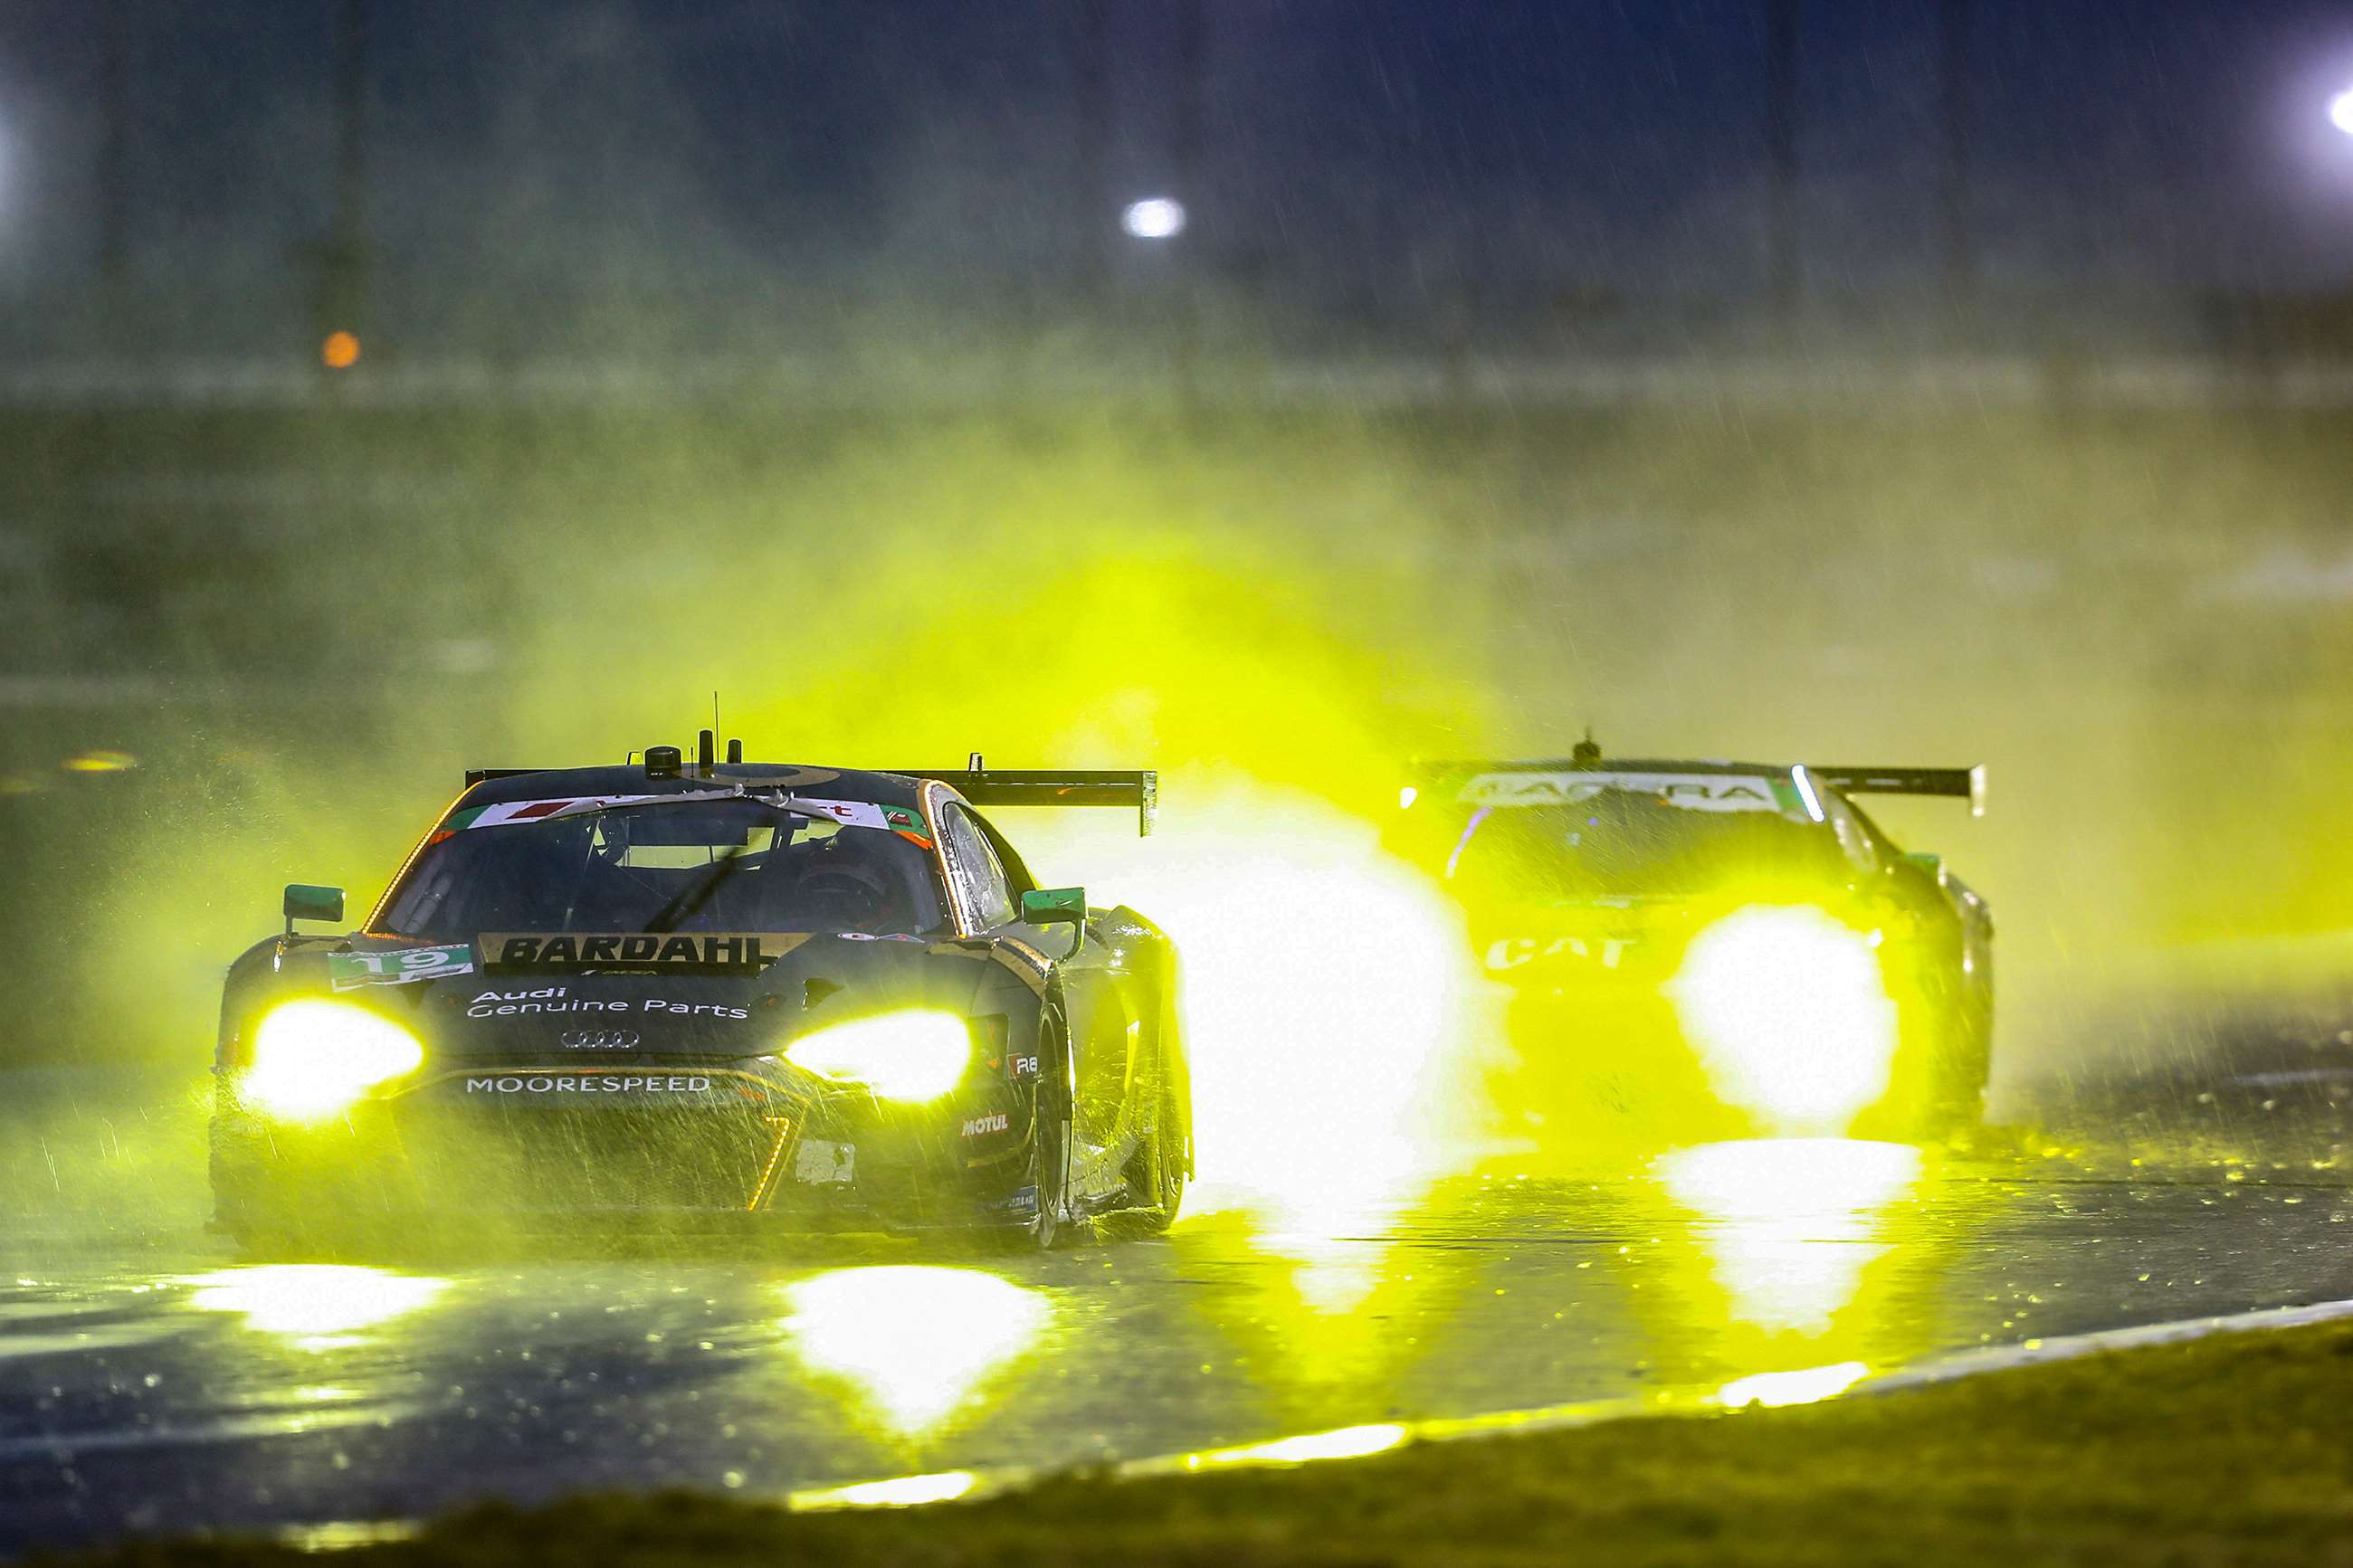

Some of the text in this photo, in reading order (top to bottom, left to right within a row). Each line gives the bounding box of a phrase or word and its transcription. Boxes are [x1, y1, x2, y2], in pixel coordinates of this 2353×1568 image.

[1512, 782, 1767, 801] ACRA
[500, 936, 778, 966] BARDAHL
[1486, 937, 1636, 970] CAT
[351, 951, 450, 973] 19
[472, 987, 567, 1003] Audi
[466, 1000, 748, 1020] Genuine Parts
[1015, 1056, 1038, 1074] R8
[467, 1077, 710, 1093] MOORESPEED
[961, 1114, 1008, 1136] MOTUL
